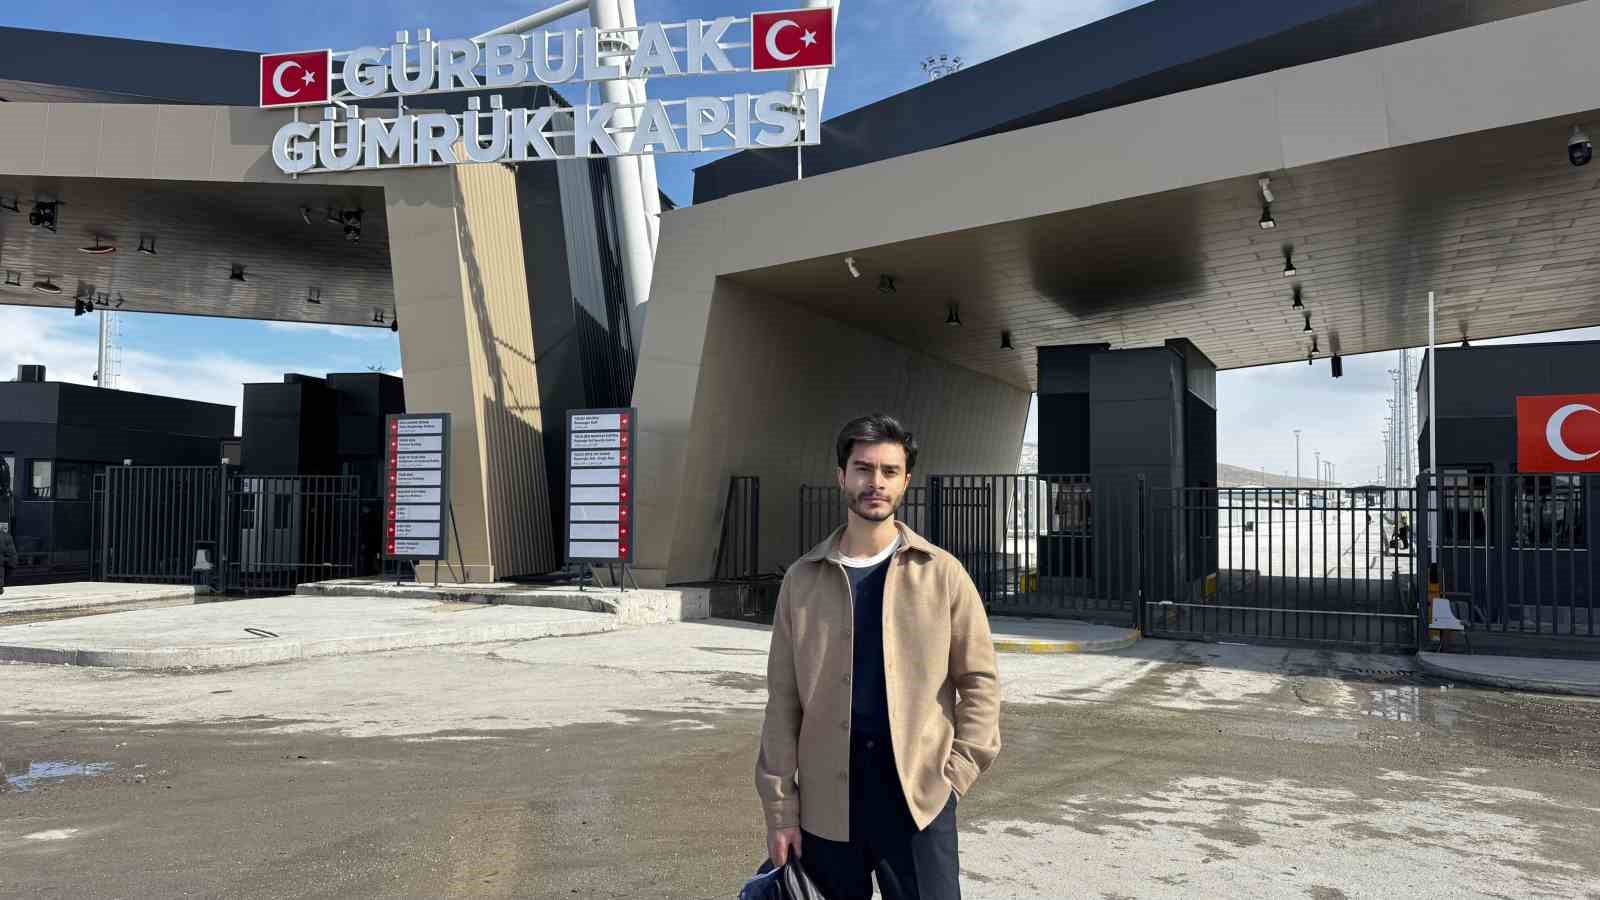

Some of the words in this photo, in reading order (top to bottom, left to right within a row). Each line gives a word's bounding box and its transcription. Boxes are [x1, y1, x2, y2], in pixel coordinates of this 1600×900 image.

[343, 16, 736, 97] GÜRBULAK
[272, 94, 561, 174] GÜMRÜK
[574, 88, 820, 157] KAPISI
